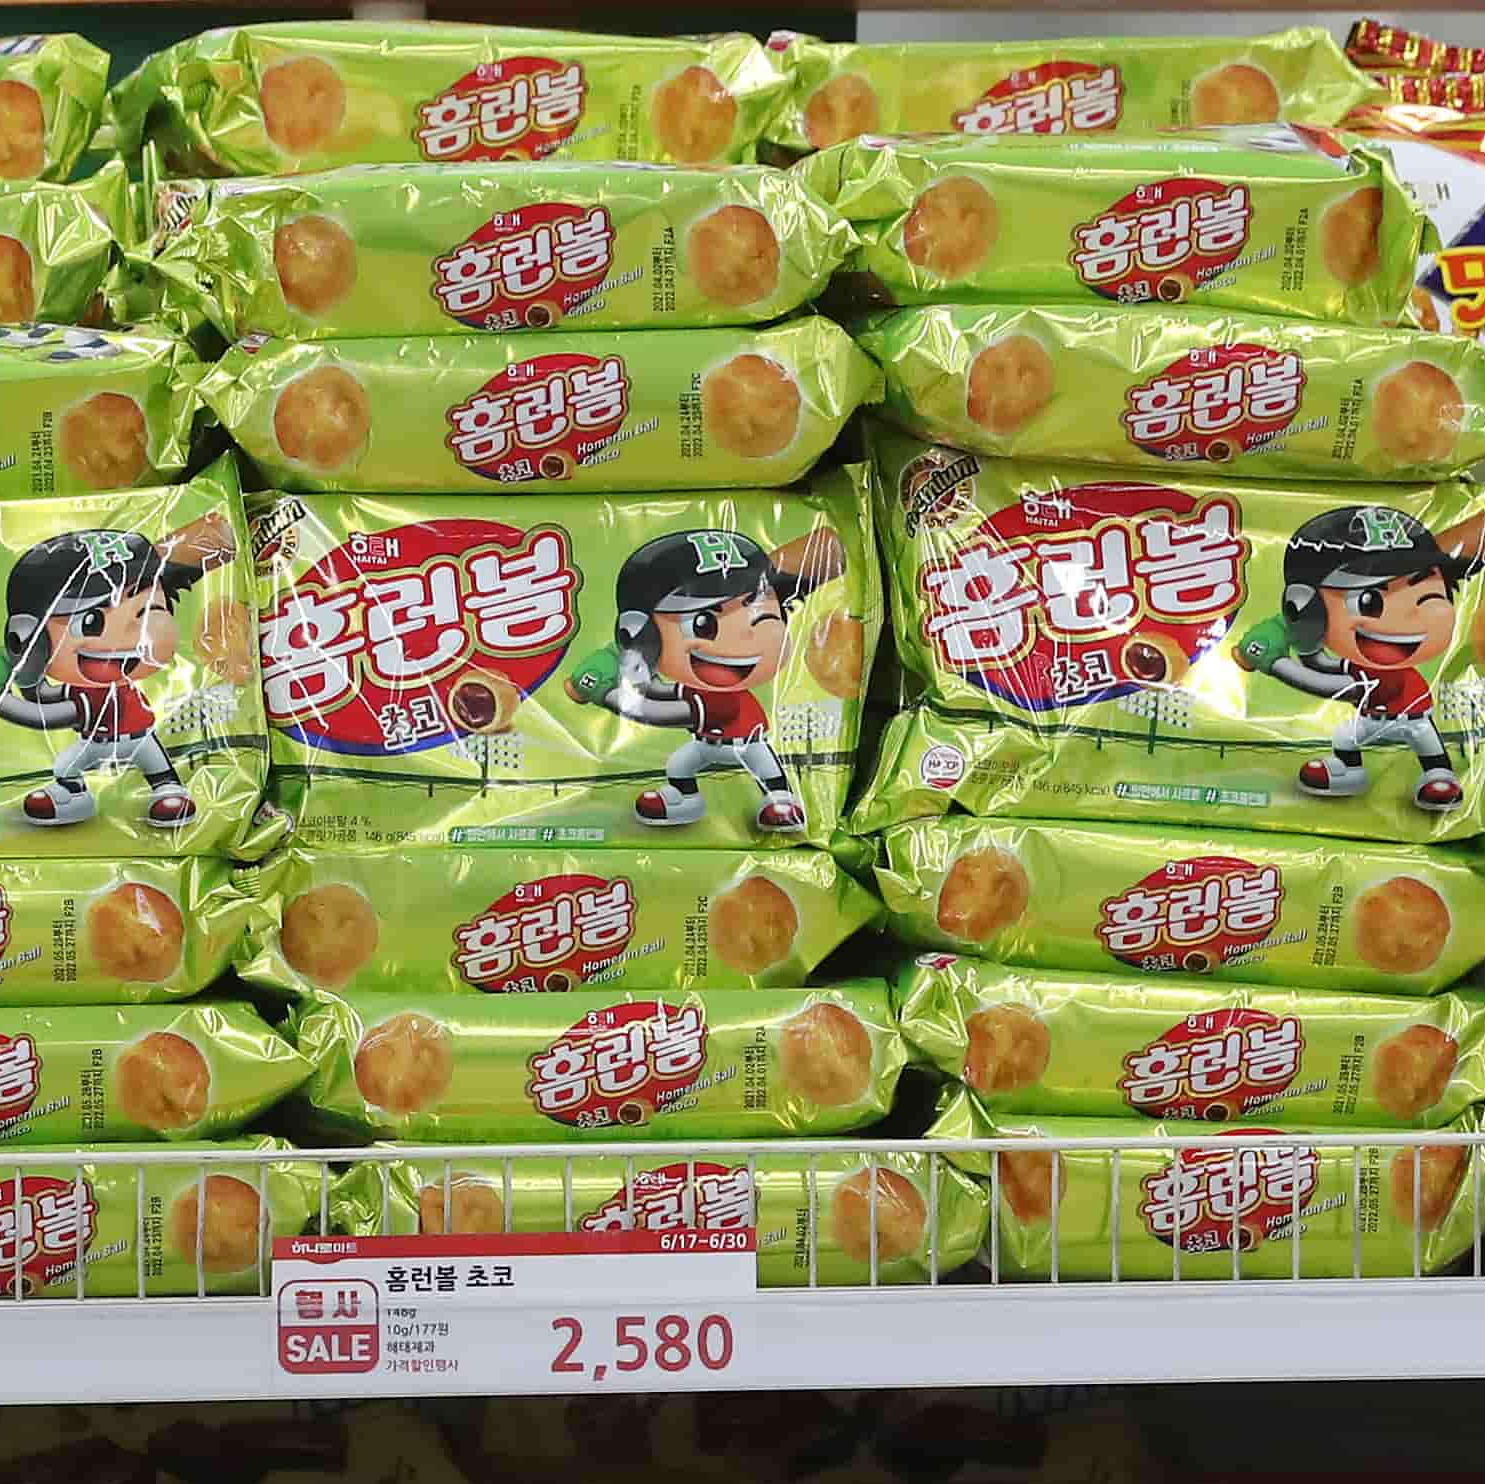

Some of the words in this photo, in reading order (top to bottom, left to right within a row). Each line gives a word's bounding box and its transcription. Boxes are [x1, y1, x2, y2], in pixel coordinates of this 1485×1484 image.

[437, 210, 612, 314] 홈런볼
[452, 359, 626, 463] 홈런볼
[1124, 354, 1302, 441] 홈런볼
[577, 431, 632, 457] Homerun
[261, 532, 573, 715] 홈런볼
[925, 504, 1246, 664] 홈런볼
[1053, 656, 1115, 703] 초코
[380, 698, 444, 750] 초코
[459, 881, 633, 980] 홈런볼
[1101, 868, 1281, 951] 홈런볼
[1124, 1019, 1298, 1103] 홈런볼
[386, 1265, 458, 1293] 홈런볼
[465, 1263, 516, 1289] 초코
[286, 1333, 373, 1363] SALE
[550, 1314, 735, 1381] 2,580
